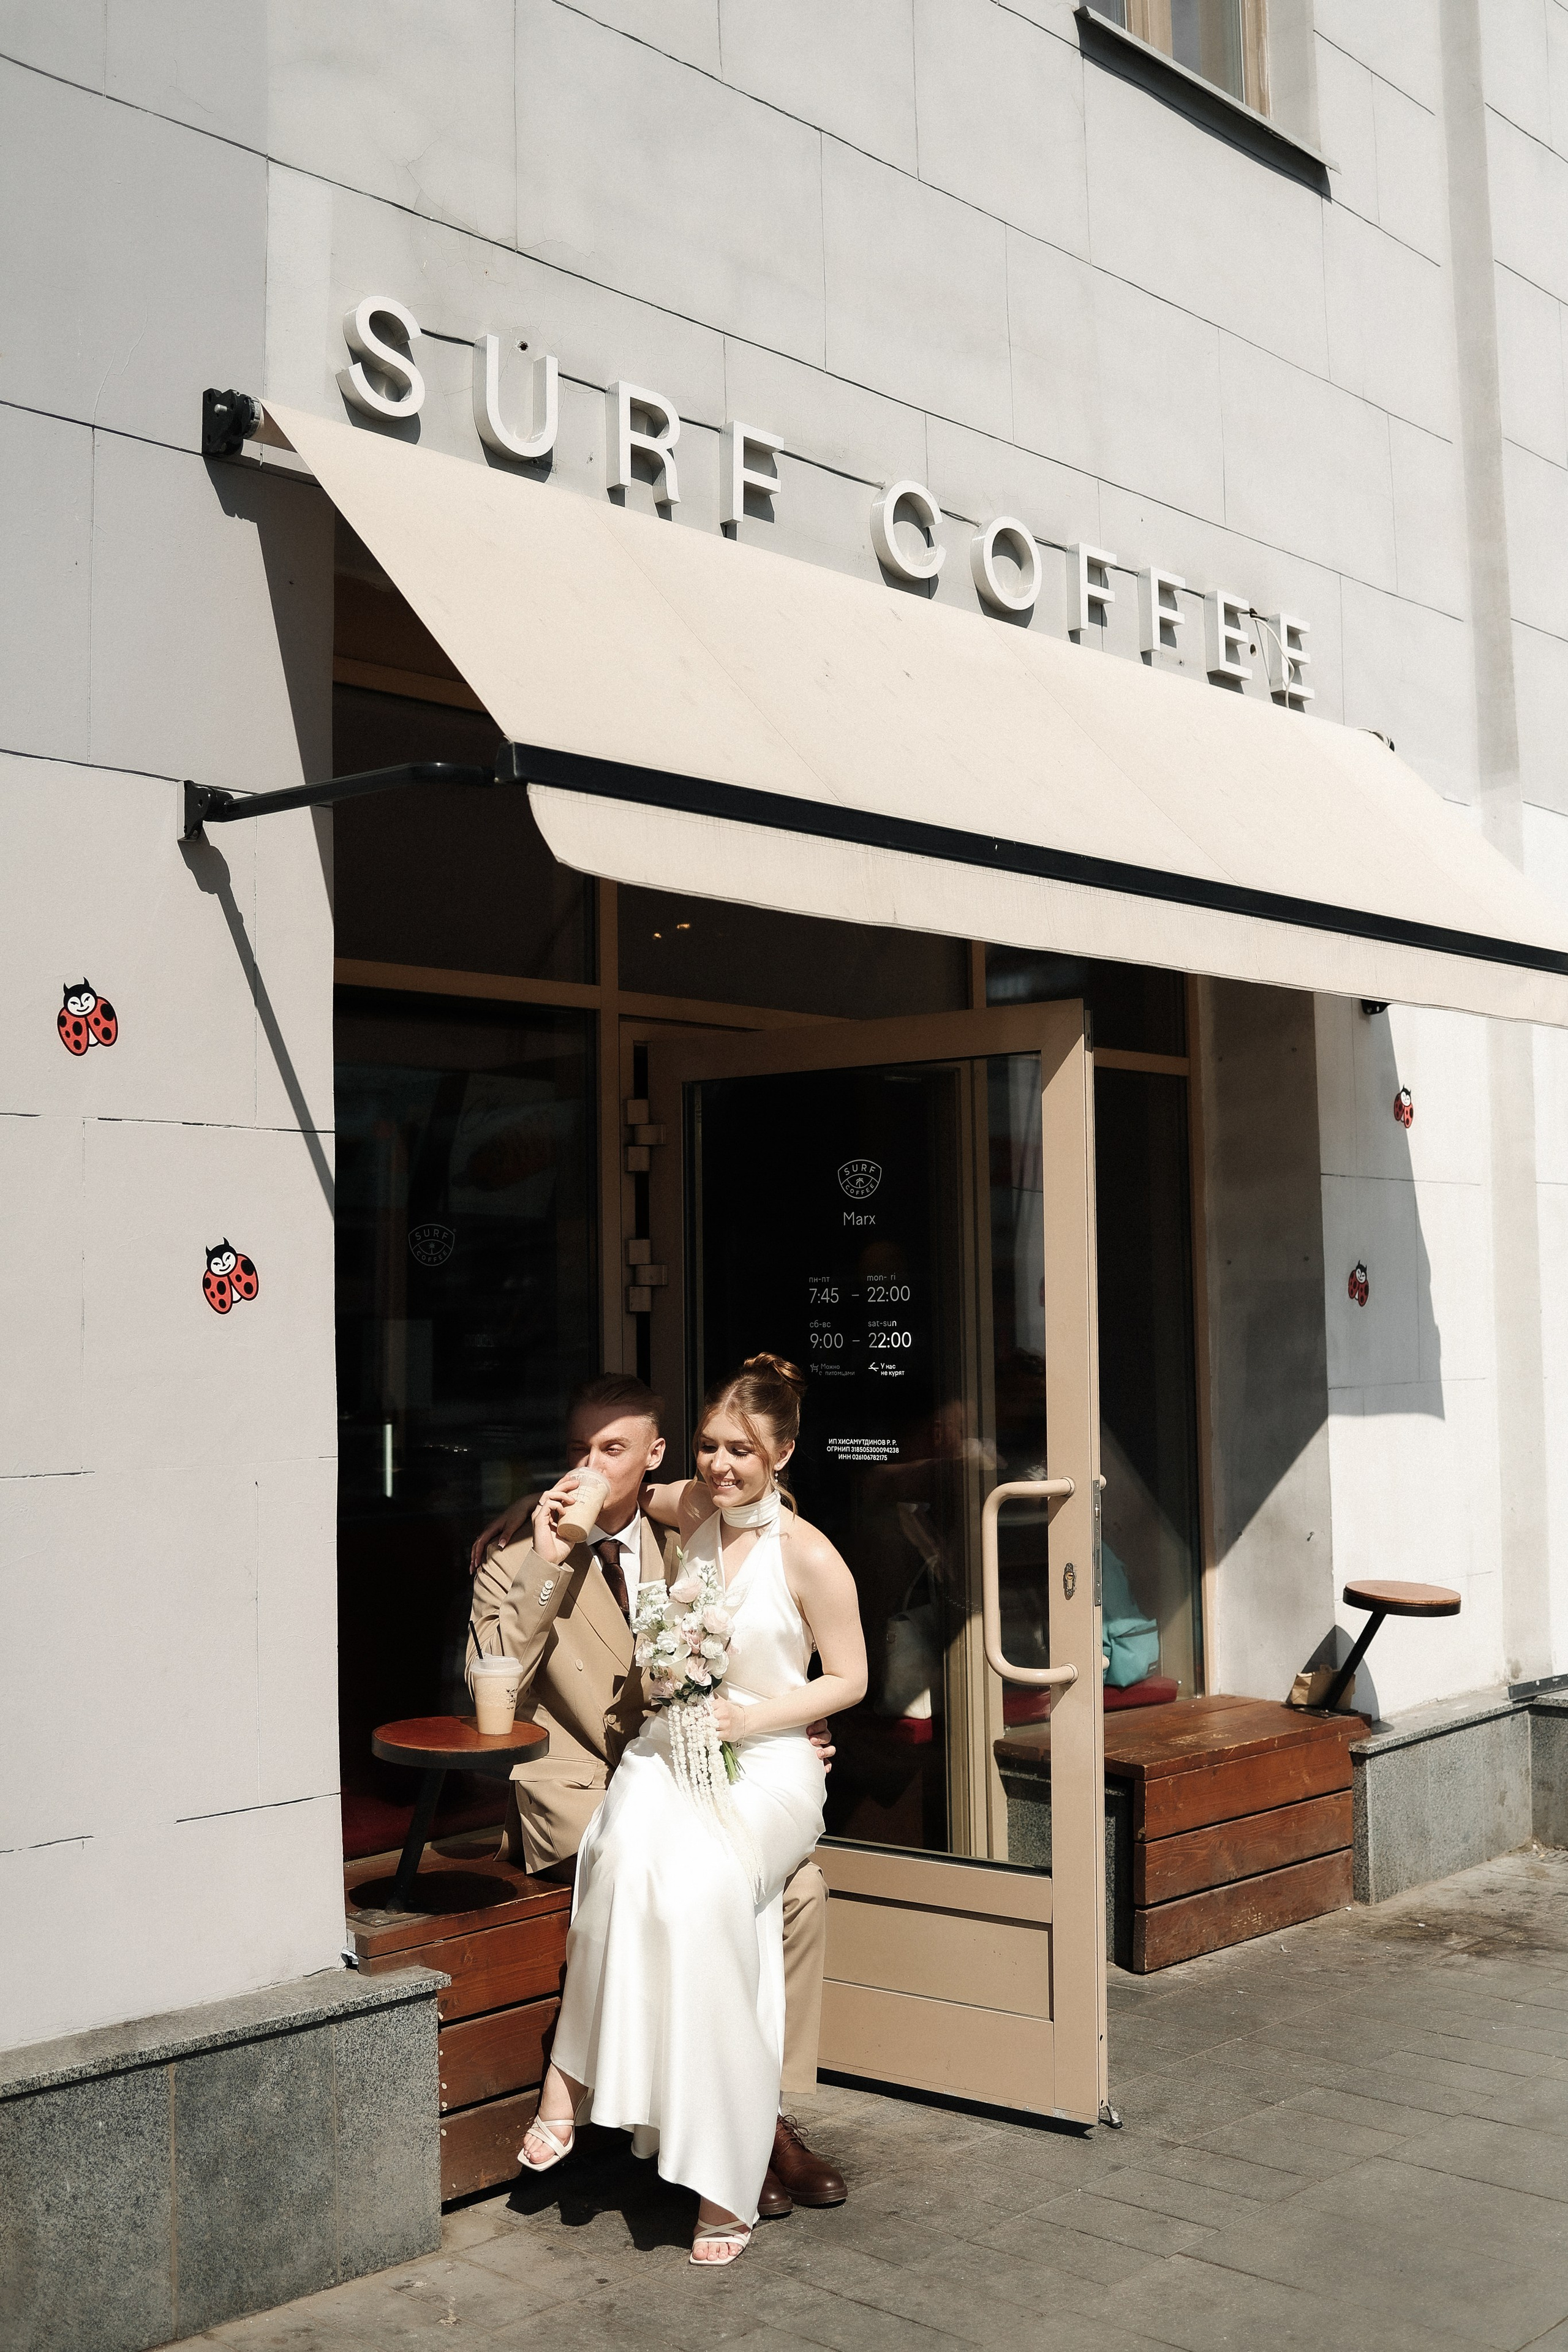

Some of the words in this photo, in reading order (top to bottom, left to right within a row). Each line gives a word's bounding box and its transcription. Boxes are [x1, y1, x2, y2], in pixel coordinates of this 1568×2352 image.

[336, 295, 785, 525] SURF
[870, 480, 1315, 701] COFFEE
[844, 1164, 876, 1175] SURF
[845, 1183, 875, 1196] COFFEE
[843, 1212, 876, 1226] Marx
[415, 1229, 449, 1240] SURF
[417, 1250, 448, 1262] COFFEE
[809, 1287, 839, 1303] 7:45
[867, 1286, 910, 1302] 22:00
[810, 1333, 843, 1349] 9:00
[869, 1332, 911, 1348] 22:00
